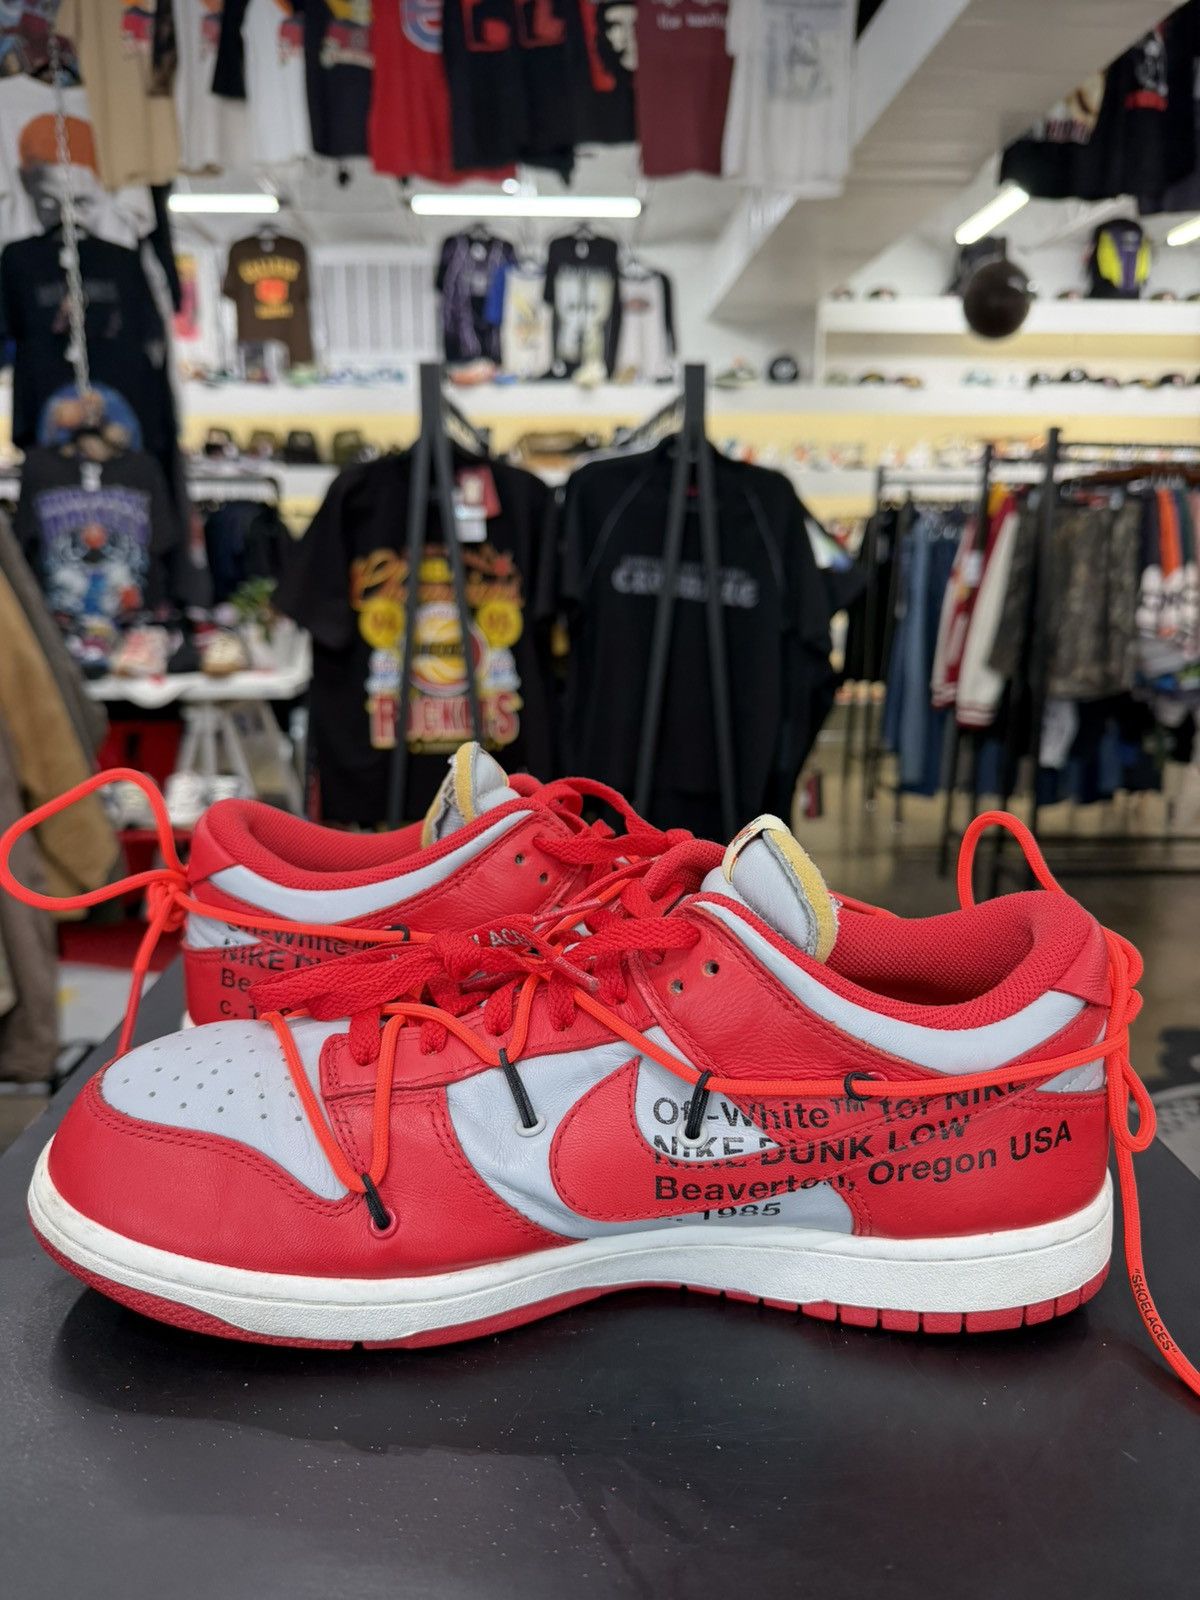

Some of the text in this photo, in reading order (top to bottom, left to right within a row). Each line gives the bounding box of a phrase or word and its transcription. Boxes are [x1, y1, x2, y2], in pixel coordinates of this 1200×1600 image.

[371, 692, 518, 742] RCKS
[653, 1096, 865, 1130] Of-White™
[653, 1113, 971, 1169] NIKE DUNK LOW
[867, 1148, 998, 1185] Oregon
[1009, 1119, 1073, 1162] USA
[702, 1202, 782, 1221] 1985
